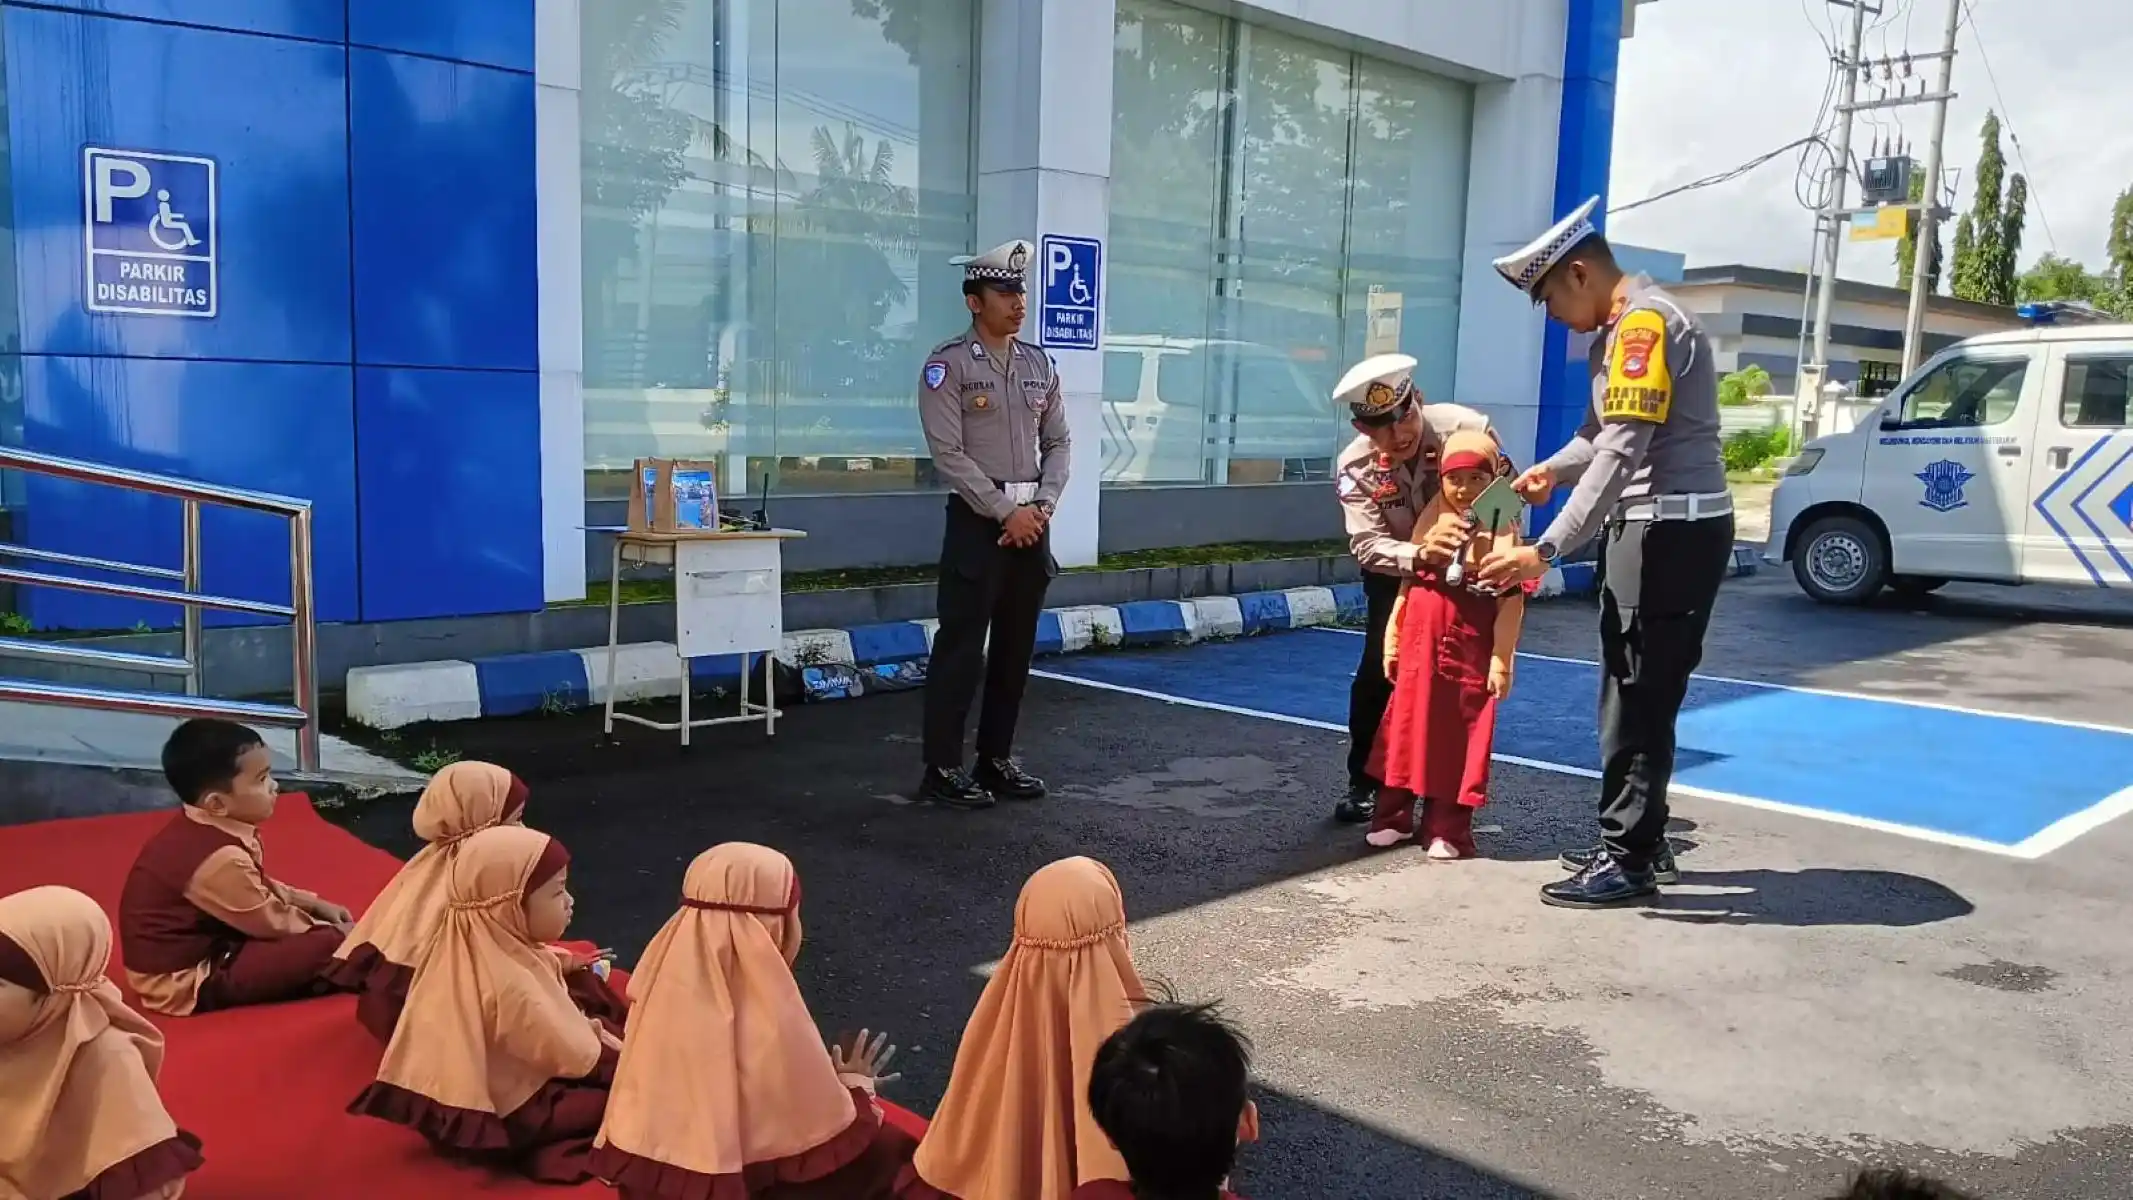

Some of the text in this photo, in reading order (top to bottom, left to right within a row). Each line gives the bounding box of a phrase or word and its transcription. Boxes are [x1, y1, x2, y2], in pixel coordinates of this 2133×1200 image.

[95, 157, 151, 222] P
[120, 262, 185, 282] PARKIR
[1048, 243, 1072, 287] P
[98, 283, 207, 306] DISABILITAS
[1056, 312, 1085, 325] PARKIR
[1046, 326, 1093, 340] DISABILITAS
